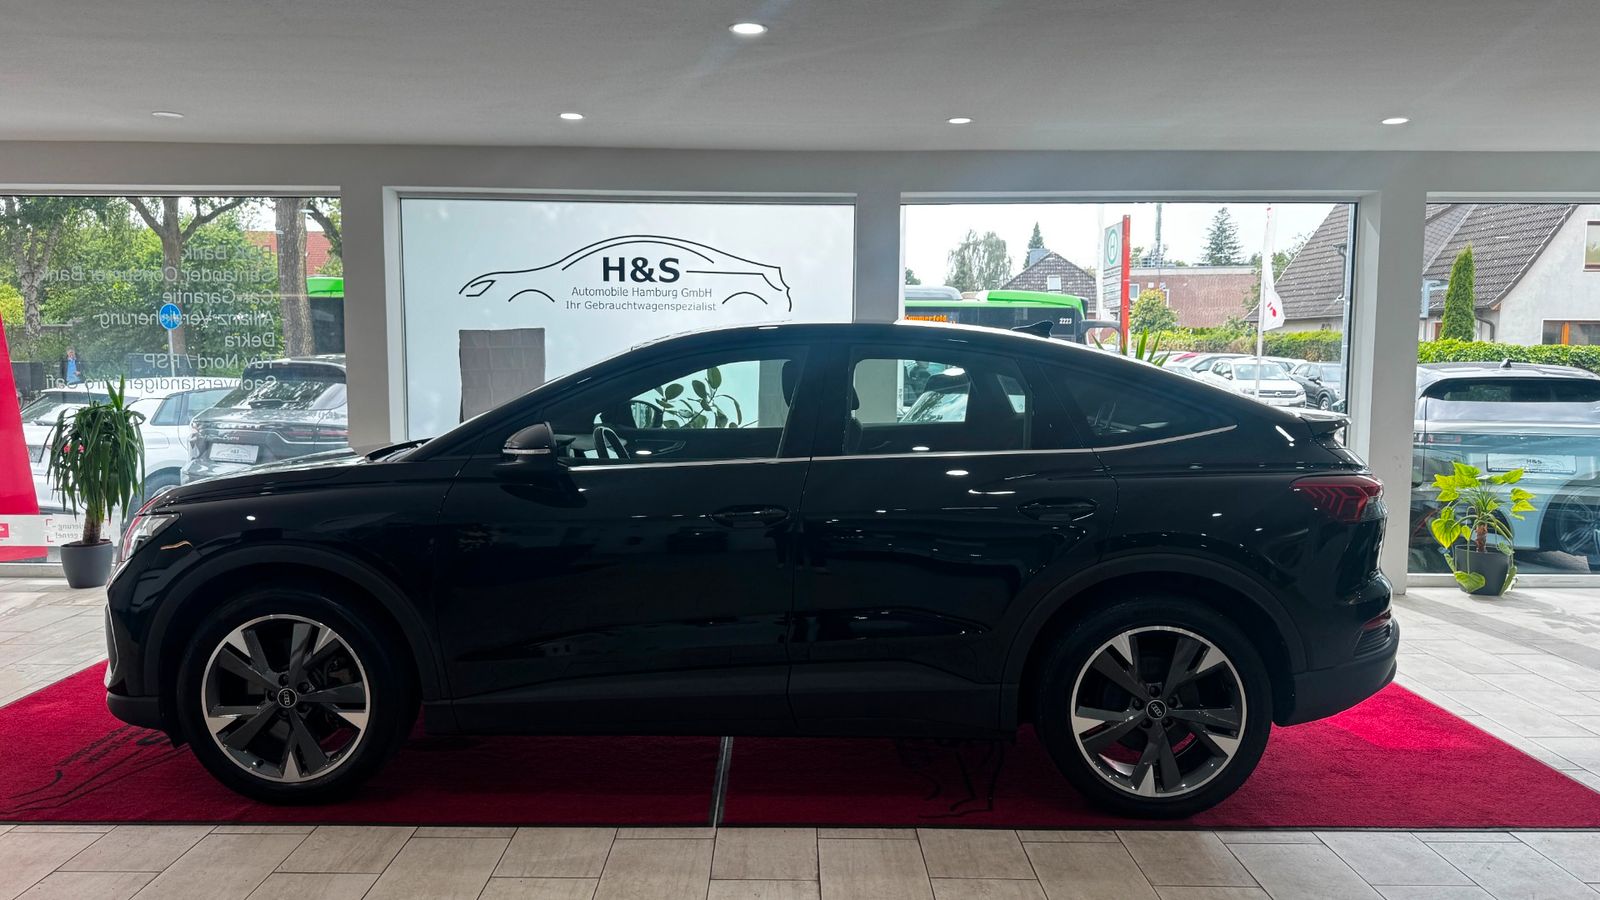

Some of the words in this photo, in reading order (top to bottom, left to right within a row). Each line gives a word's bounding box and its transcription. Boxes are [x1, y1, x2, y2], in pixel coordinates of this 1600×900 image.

[602, 256, 680, 283] H&S
[571, 286, 629, 297] Automobile
[631, 287, 678, 299] Hamburg
[680, 287, 713, 298] GmbH
[566, 300, 581, 310] Ihr
[584, 300, 717, 312] Gebrauchtwagenspezialist
